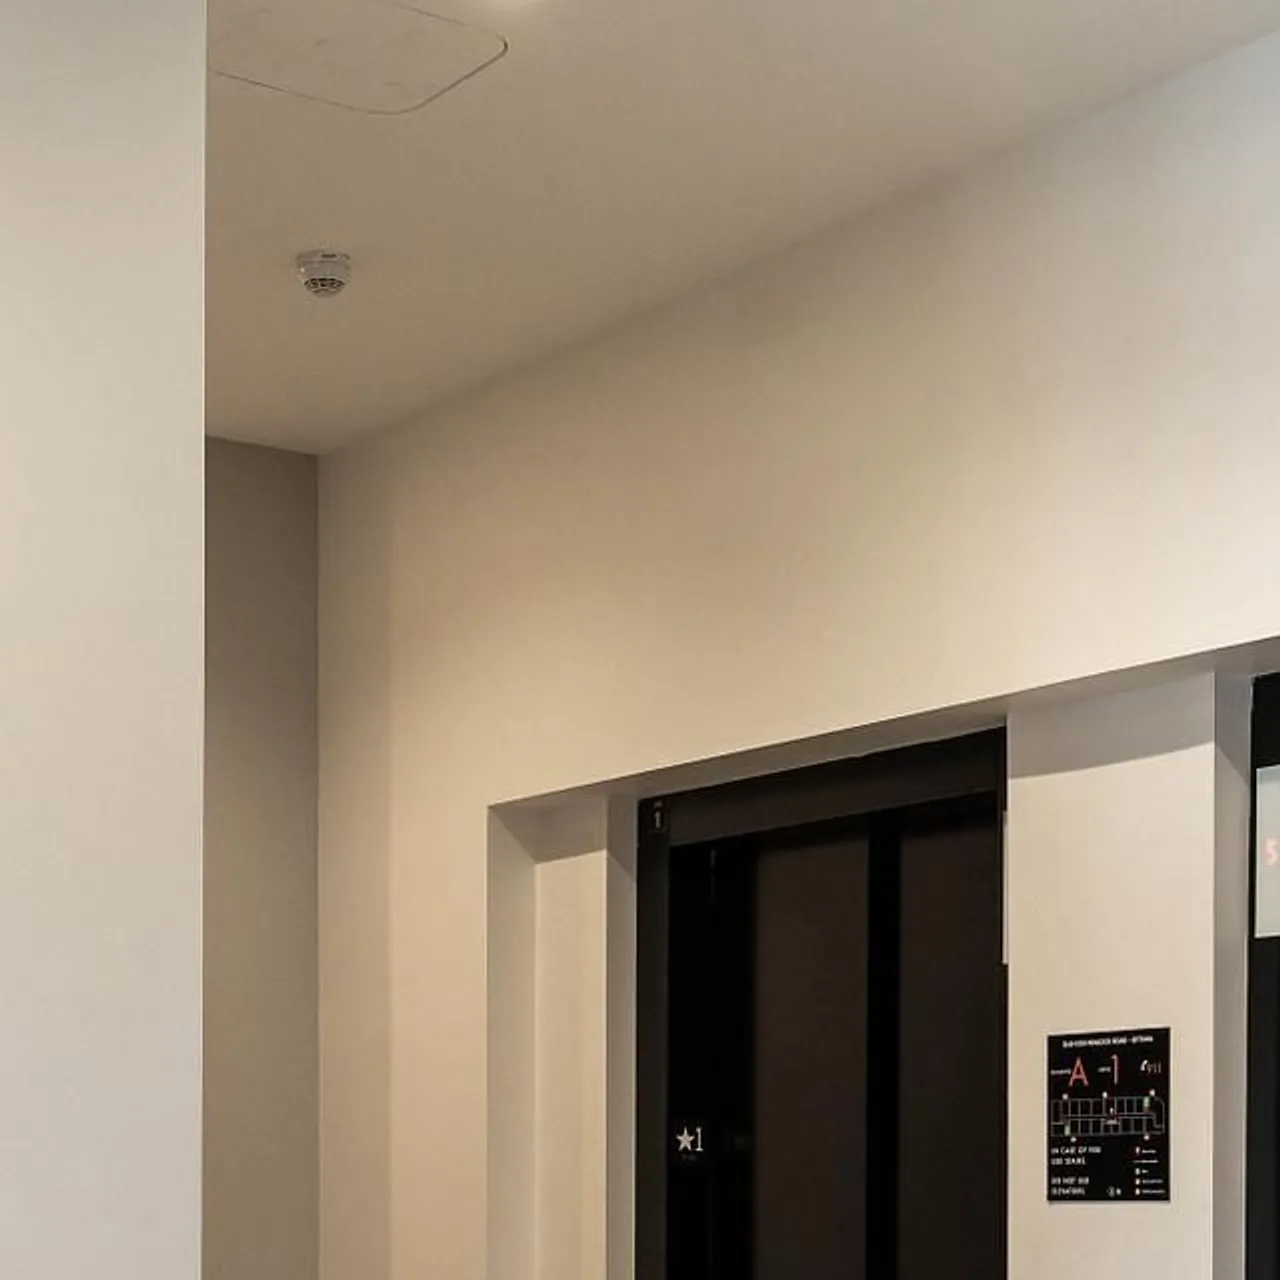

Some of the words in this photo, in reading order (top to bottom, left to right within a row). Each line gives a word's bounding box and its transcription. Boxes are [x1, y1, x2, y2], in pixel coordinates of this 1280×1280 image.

[1067, 1056, 1089, 1087] A
[1110, 1053, 1119, 1086] 1
[695, 1126, 704, 1152] 1
